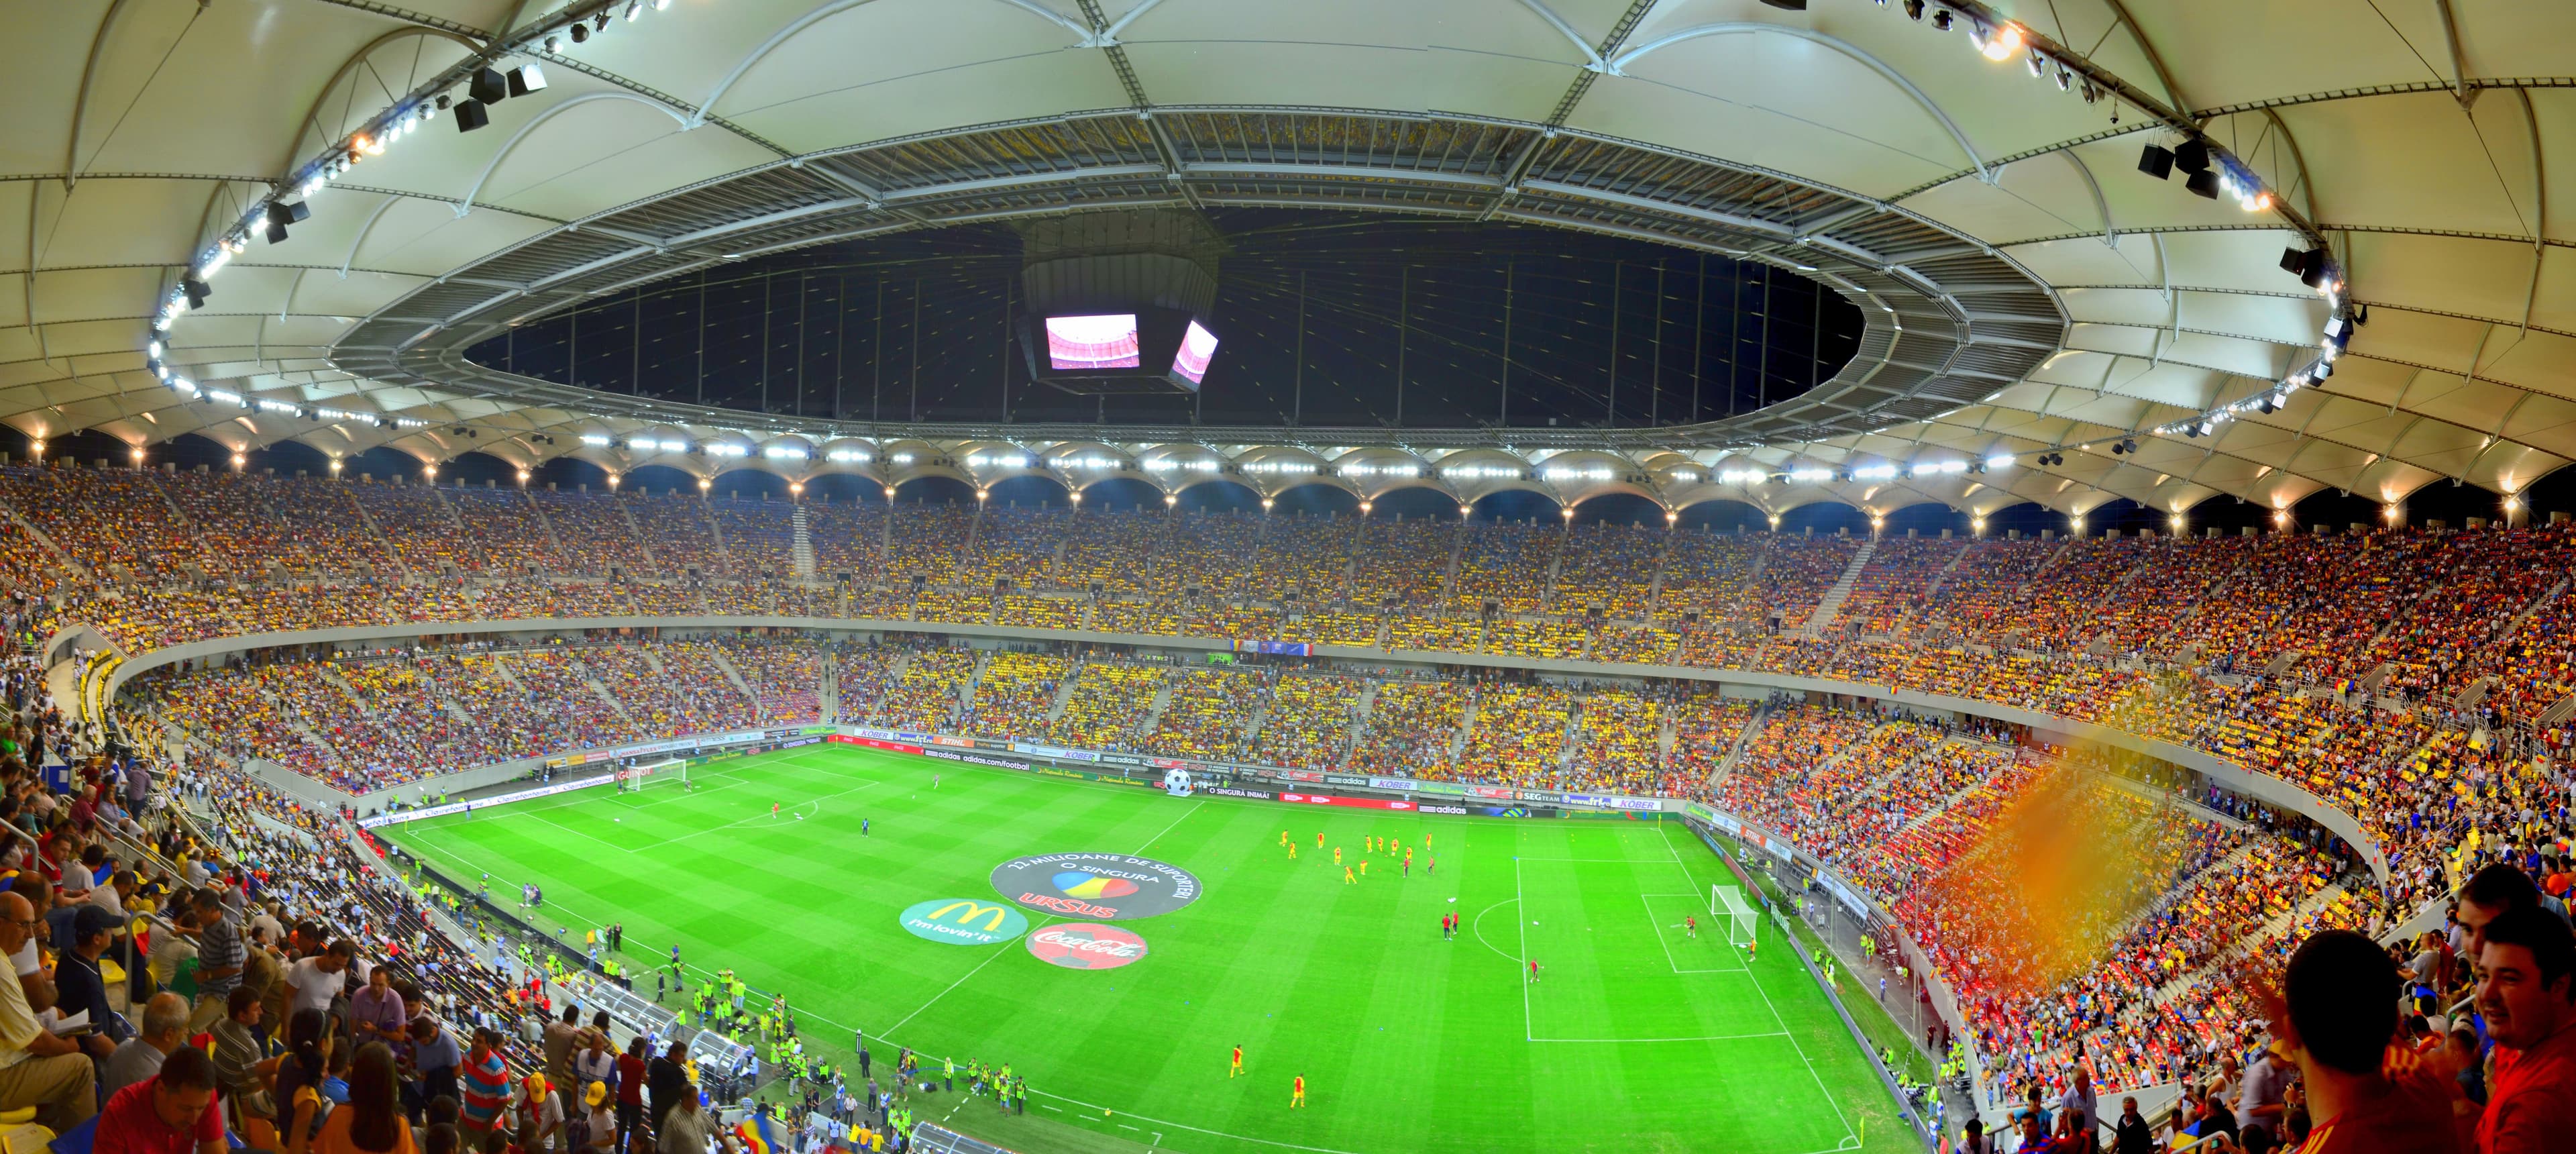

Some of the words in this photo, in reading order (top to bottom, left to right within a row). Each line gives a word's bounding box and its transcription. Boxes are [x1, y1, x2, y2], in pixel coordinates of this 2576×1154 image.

[941, 737, 965, 747] STIHL
[938, 749, 961, 761] adidas
[963, 754, 1030, 771] adidas.com/football
[1117, 756, 1140, 765] adidas
[1342, 777, 1366, 786] adidas
[1523, 792, 1542, 801] SEG
[1436, 805, 1467, 815] adidas
[1744, 828, 1761, 843] STIHL
[1008, 861, 1031, 870] 22
[1030, 853, 1121, 866] MILIOANE
[1125, 855, 1150, 866] DE
[1149, 863, 1195, 900] SUPORTERI
[1079, 865, 1160, 884] SINGURA
[1018, 892, 1118, 918] URSUS
